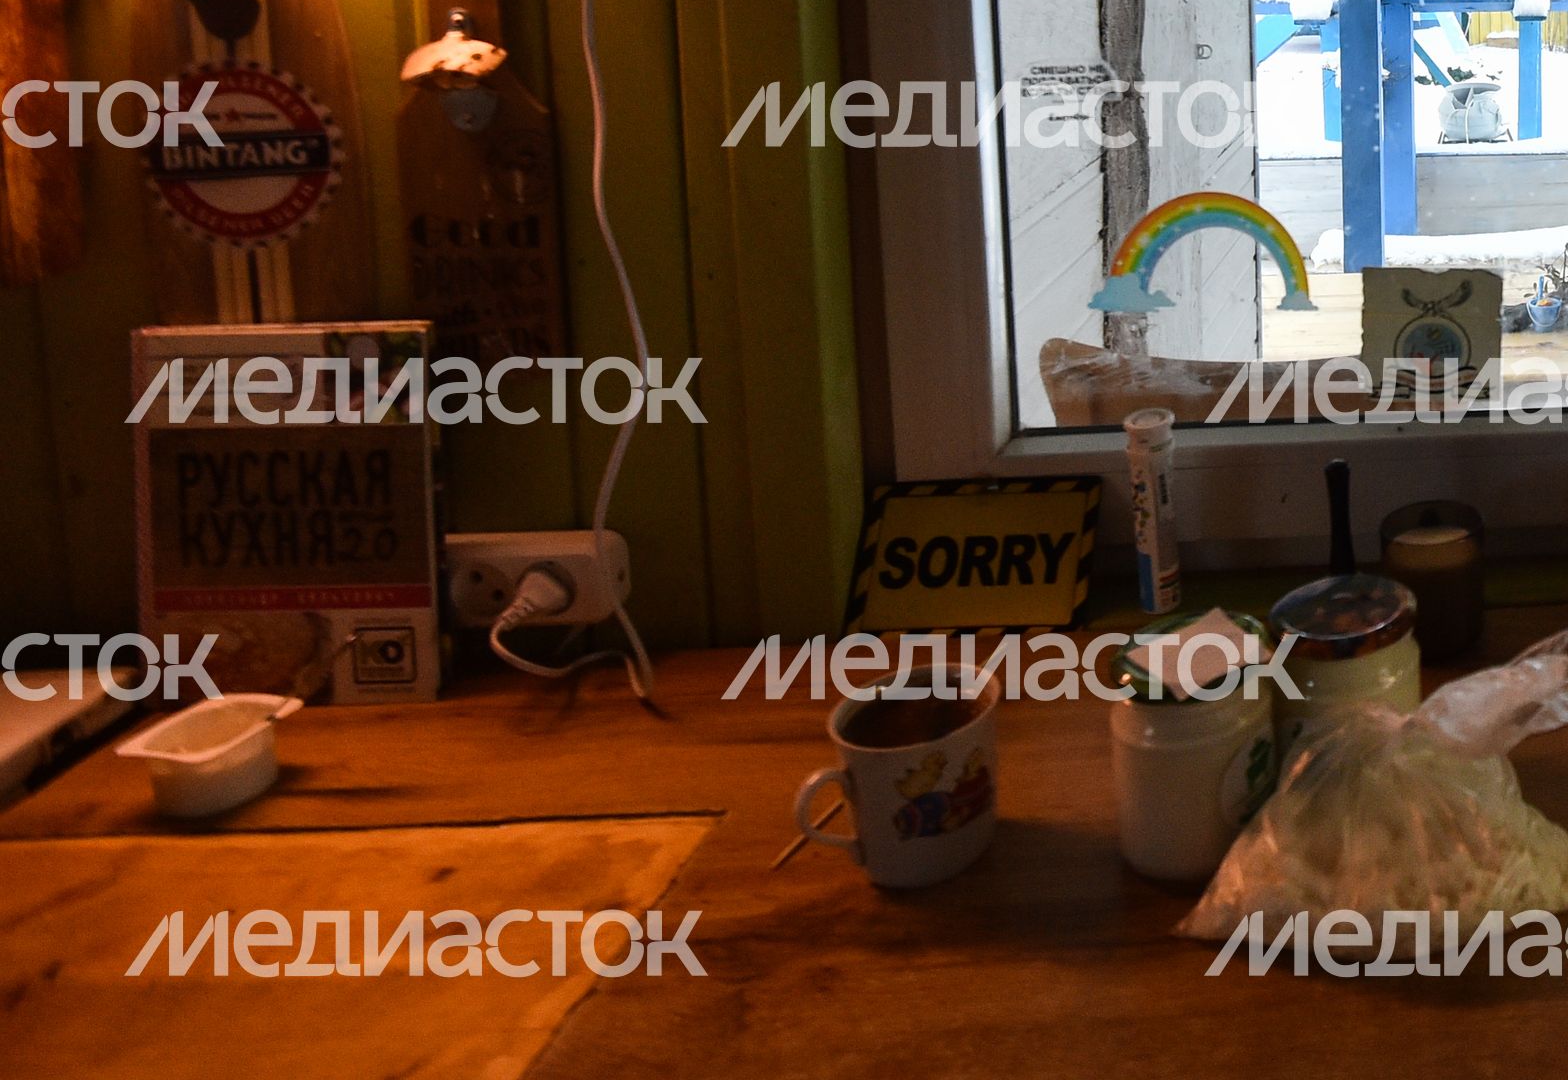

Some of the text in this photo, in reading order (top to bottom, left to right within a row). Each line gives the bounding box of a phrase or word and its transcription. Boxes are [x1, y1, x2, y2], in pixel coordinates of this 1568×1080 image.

[162, 139, 308, 171] BINTANG
[175, 450, 391, 509] РУССКАЯ
[177, 508, 338, 568] КУХНЯ
[878, 531, 1077, 590] SORRY
